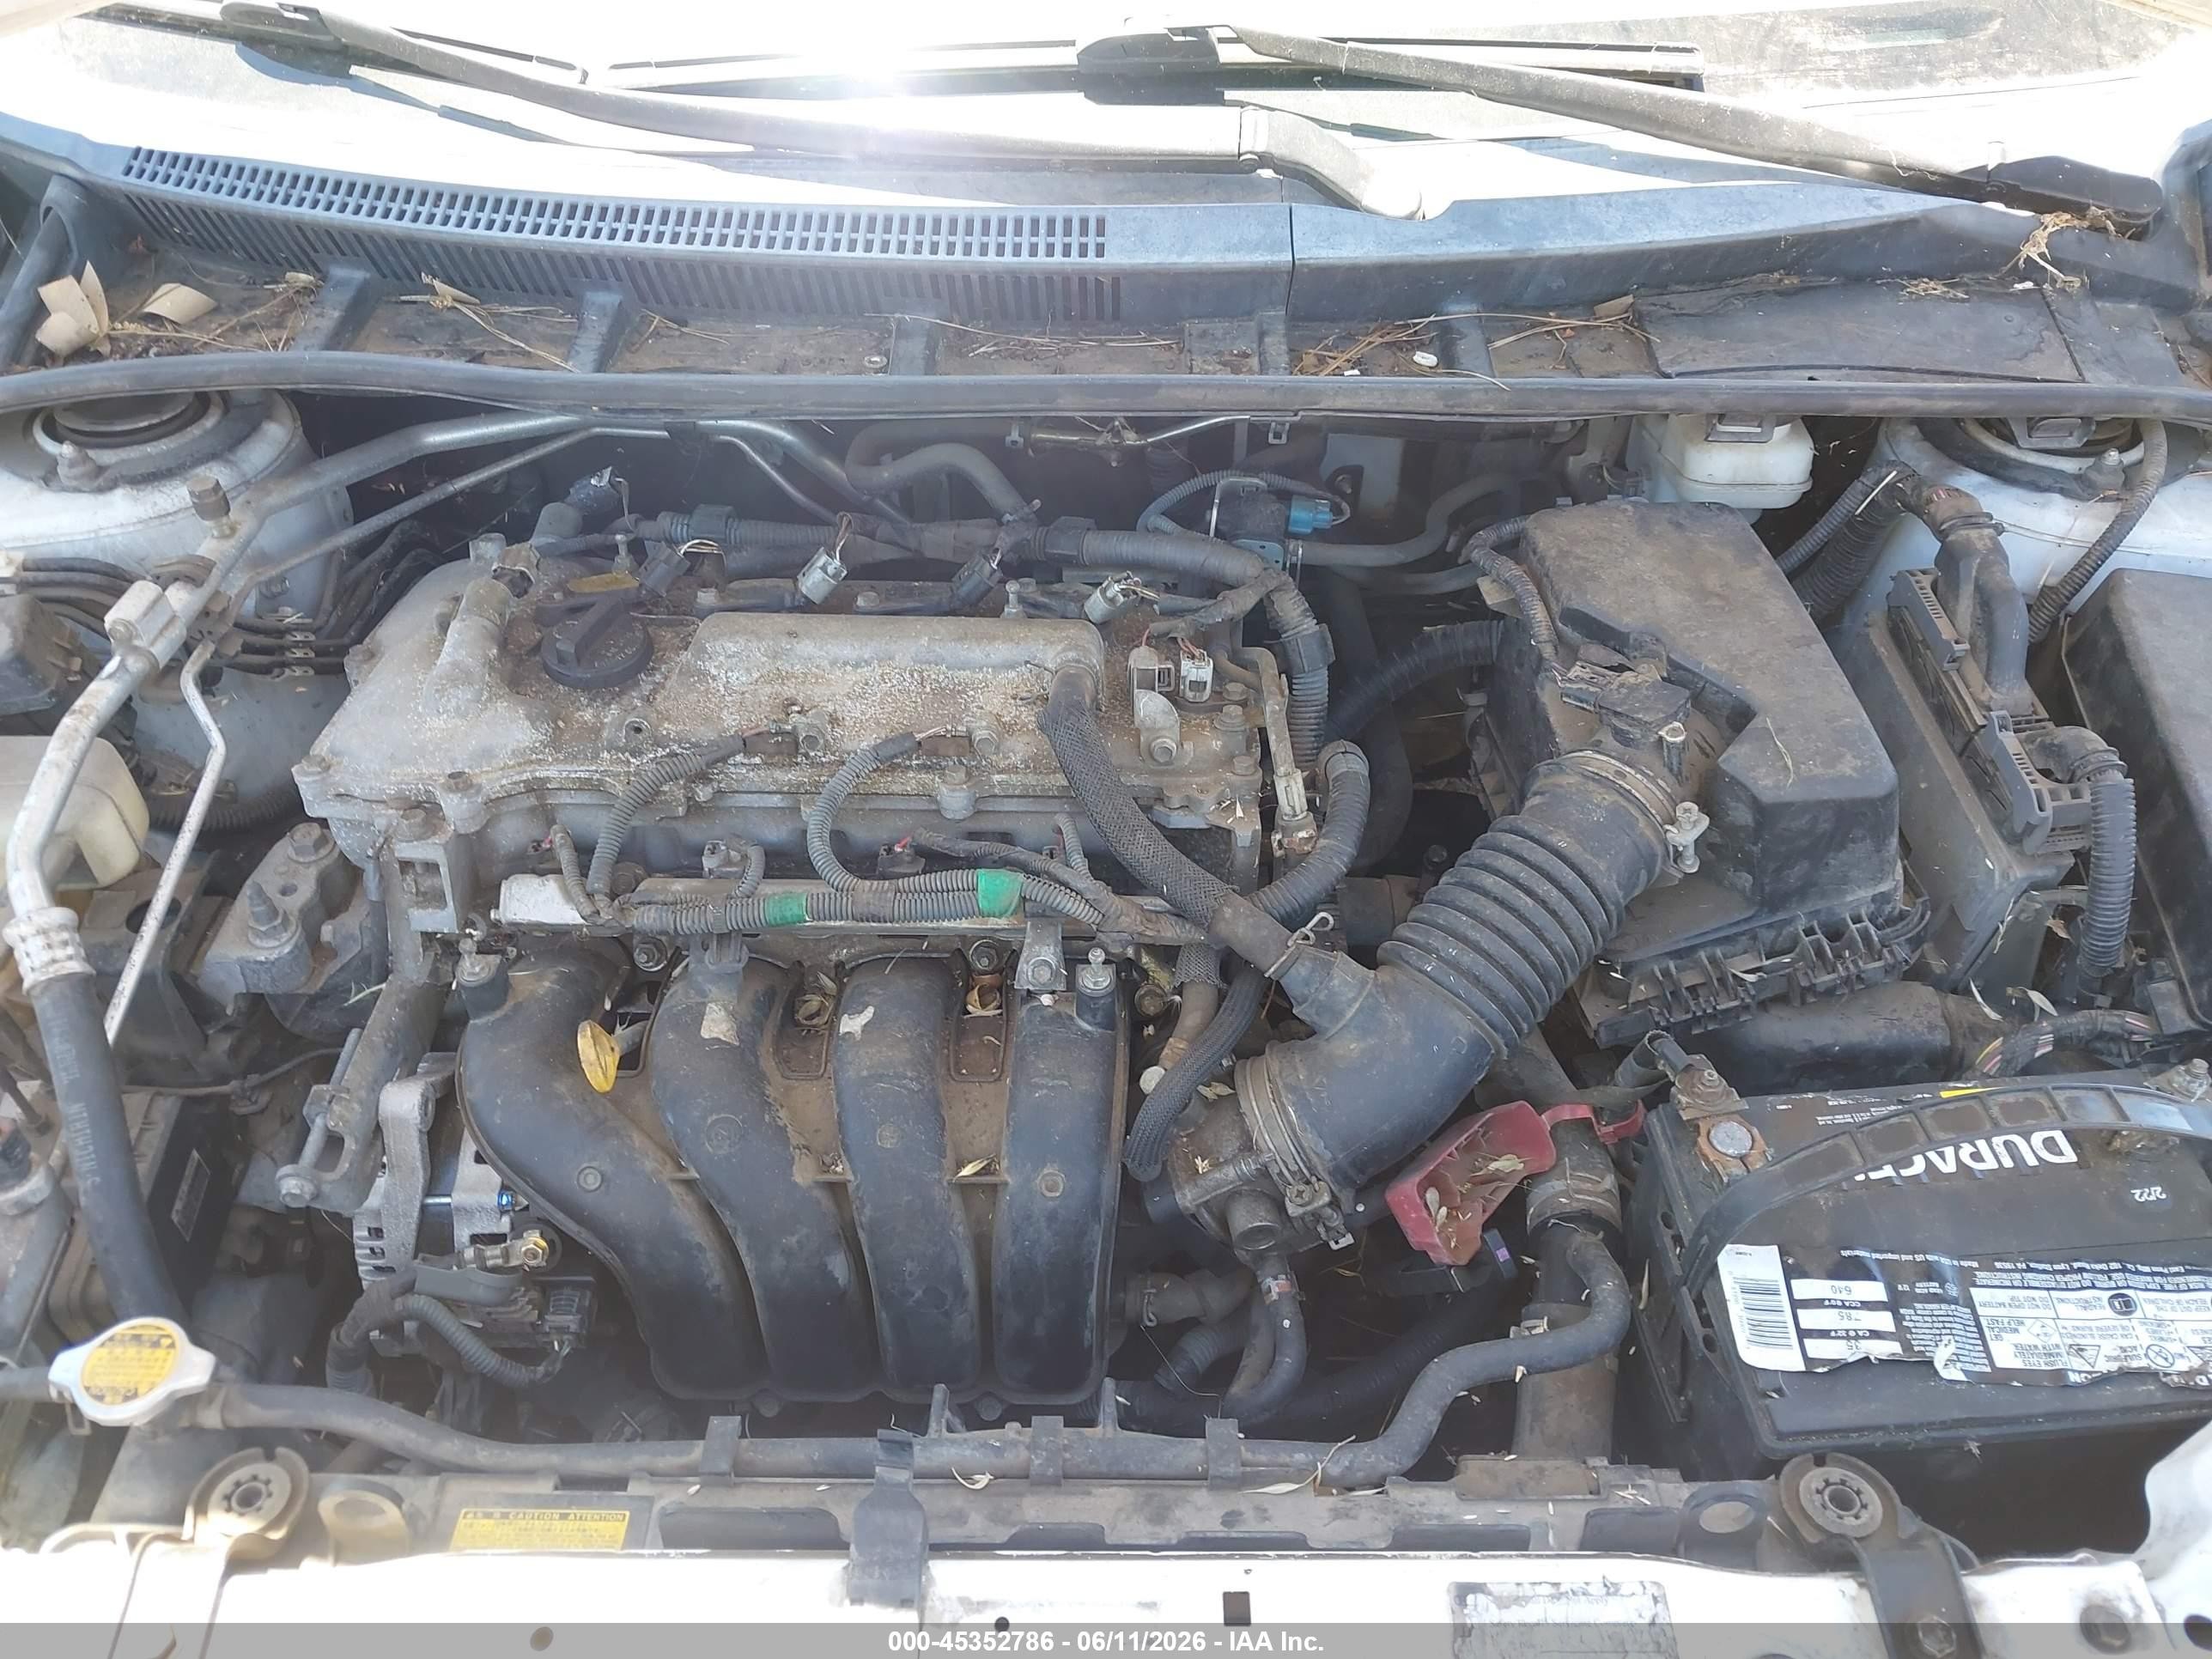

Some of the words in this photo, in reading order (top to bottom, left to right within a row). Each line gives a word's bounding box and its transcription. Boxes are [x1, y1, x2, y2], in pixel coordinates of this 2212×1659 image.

[66, 1102, 97, 1172] NICHIRIN
[1854, 1130, 2078, 1182] DURAC
[1831, 1285, 1851, 1294] 640
[1846, 1340, 1861, 1350] 35
[568, 1512, 624, 1521] ATTENTION
